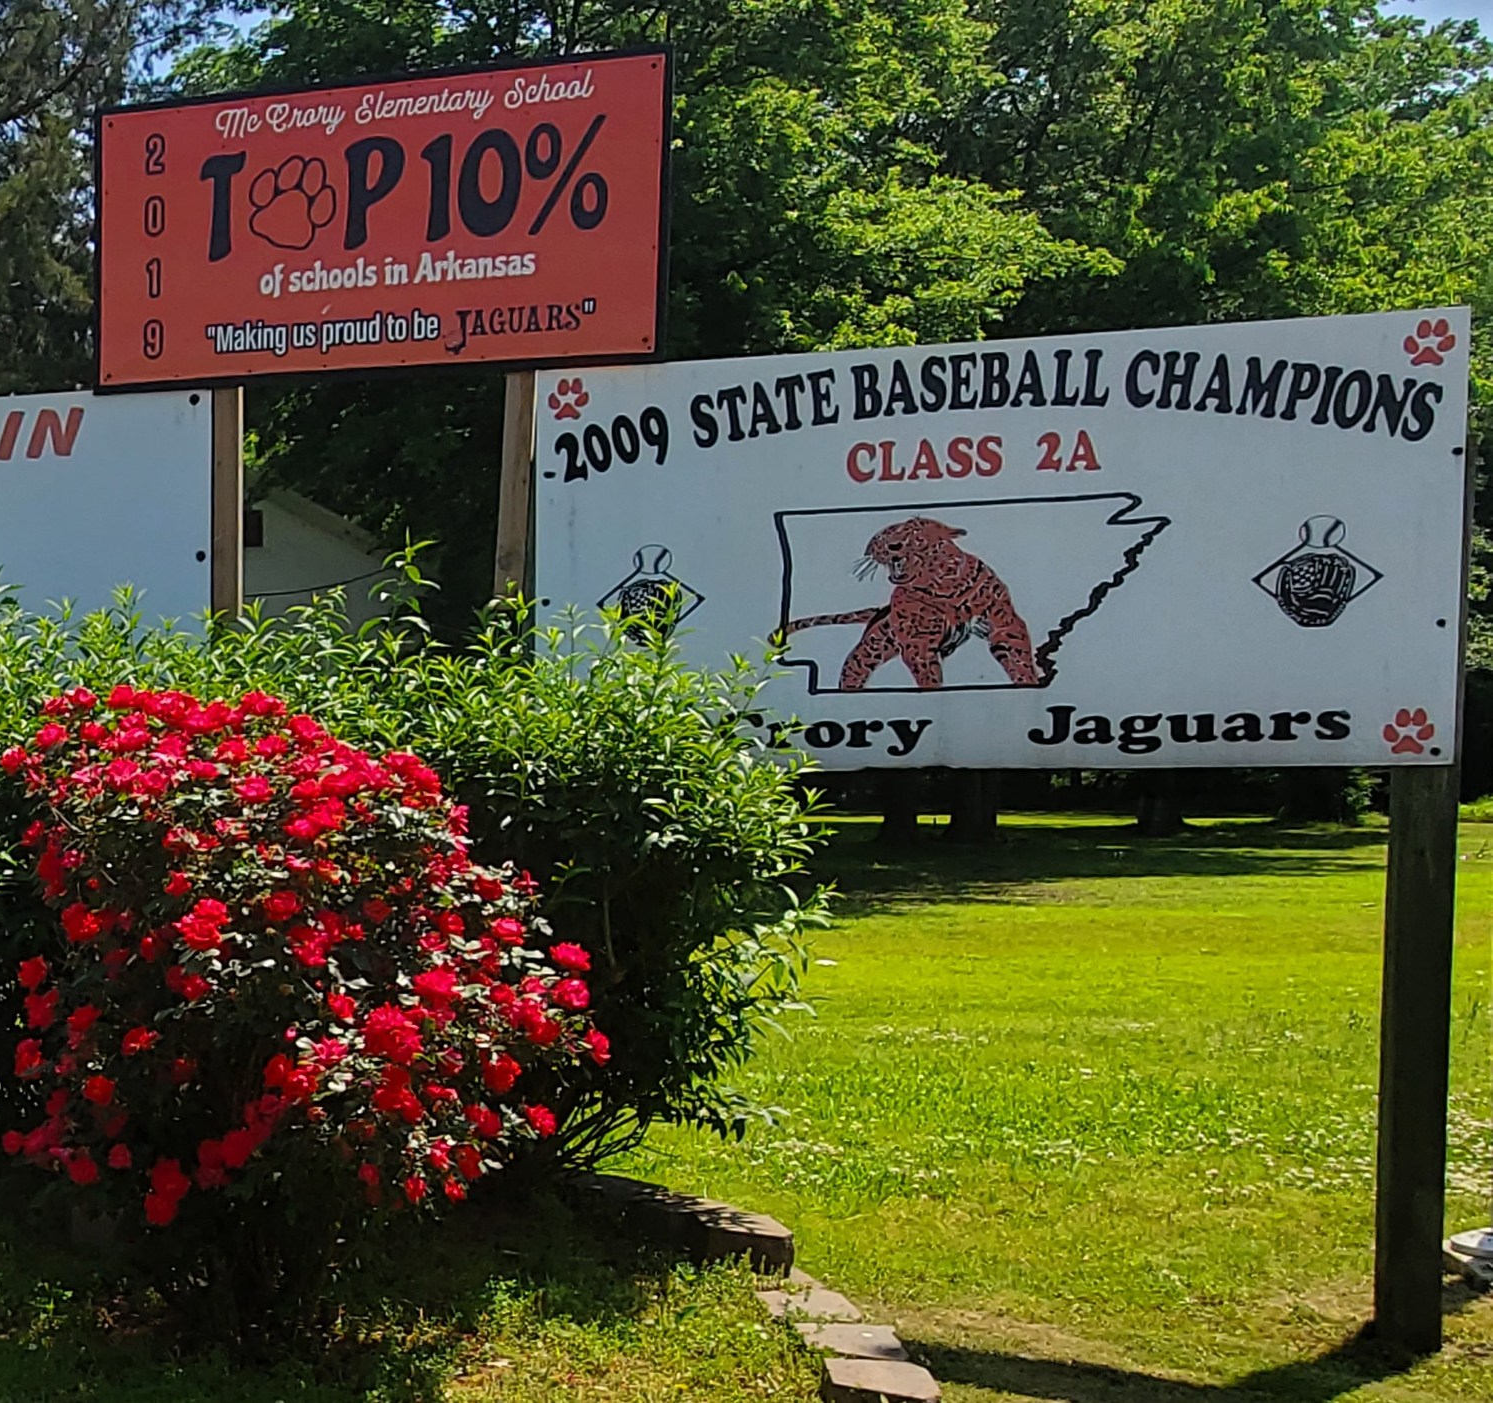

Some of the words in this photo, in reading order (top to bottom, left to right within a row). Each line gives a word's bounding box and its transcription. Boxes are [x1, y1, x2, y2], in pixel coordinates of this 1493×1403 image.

[215, 106, 262, 139] Mc
[265, 103, 346, 135] Crory
[354, 86, 495, 124] Elementary
[504, 69, 596, 108] School
[420, 113, 608, 241] 10%
[259, 262, 286, 299] of
[288, 256, 378, 294] schools
[384, 256, 409, 286] in
[413, 250, 537, 284] Arkansas
[291, 322, 317, 349] us
[321, 313, 381, 353] proud
[385, 313, 407, 341] to
[411, 309, 441, 341] be
[553, 405, 669, 483] 2009
[689, 367, 839, 449] STATE
[851, 349, 1109, 421] BASEBALL
[1124, 349, 1443, 442] CHAMPIONS
[845, 435, 1004, 484] CLASS
[1035, 429, 1103, 474] 2A
[1027, 704, 1352, 754] Jaguars
